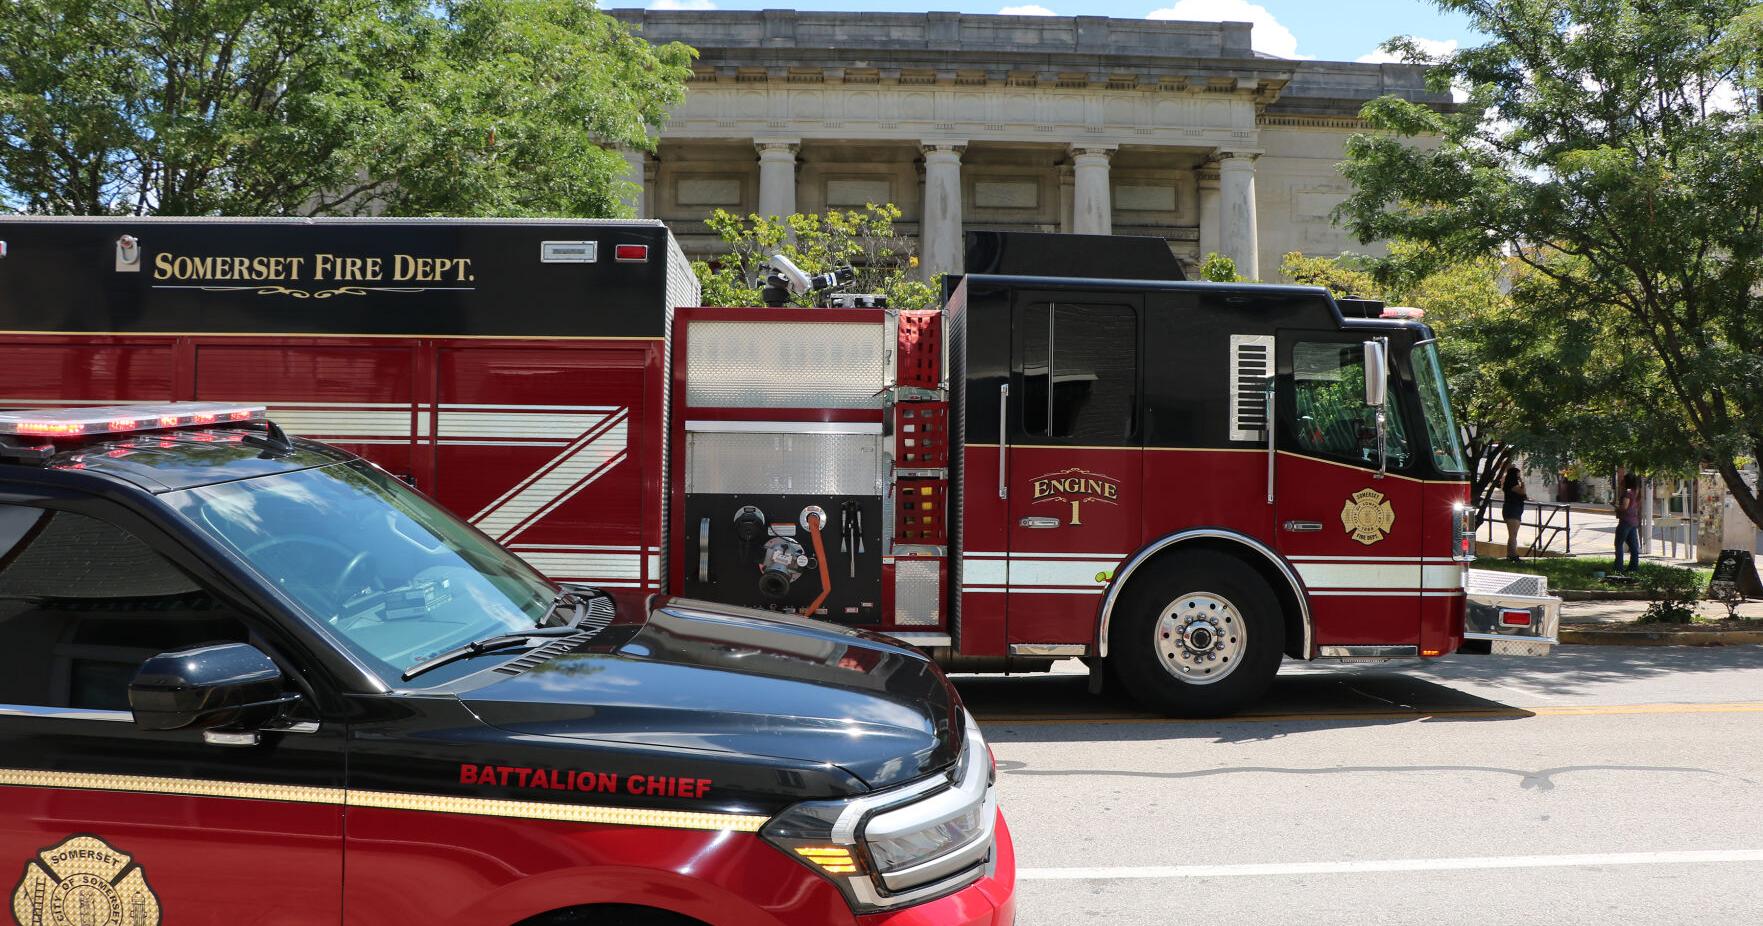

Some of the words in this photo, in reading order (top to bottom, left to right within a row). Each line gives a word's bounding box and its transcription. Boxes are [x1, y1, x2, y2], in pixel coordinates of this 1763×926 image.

[153, 252, 304, 280] SOMERSET
[313, 254, 383, 281] FIRE
[393, 254, 475, 282] DEPT.
[1033, 478, 1118, 500] ENGINE
[1356, 491, 1380, 499] SOMERSET
[1069, 500, 1083, 525] 1
[460, 763, 617, 793] BATTALION
[626, 774, 713, 798] CHIEF
[51, 849, 120, 868] SOMERSET
[53, 895, 65, 922] CITY
[61, 878, 75, 891] OF
[82, 875, 121, 924] SOMERSET
